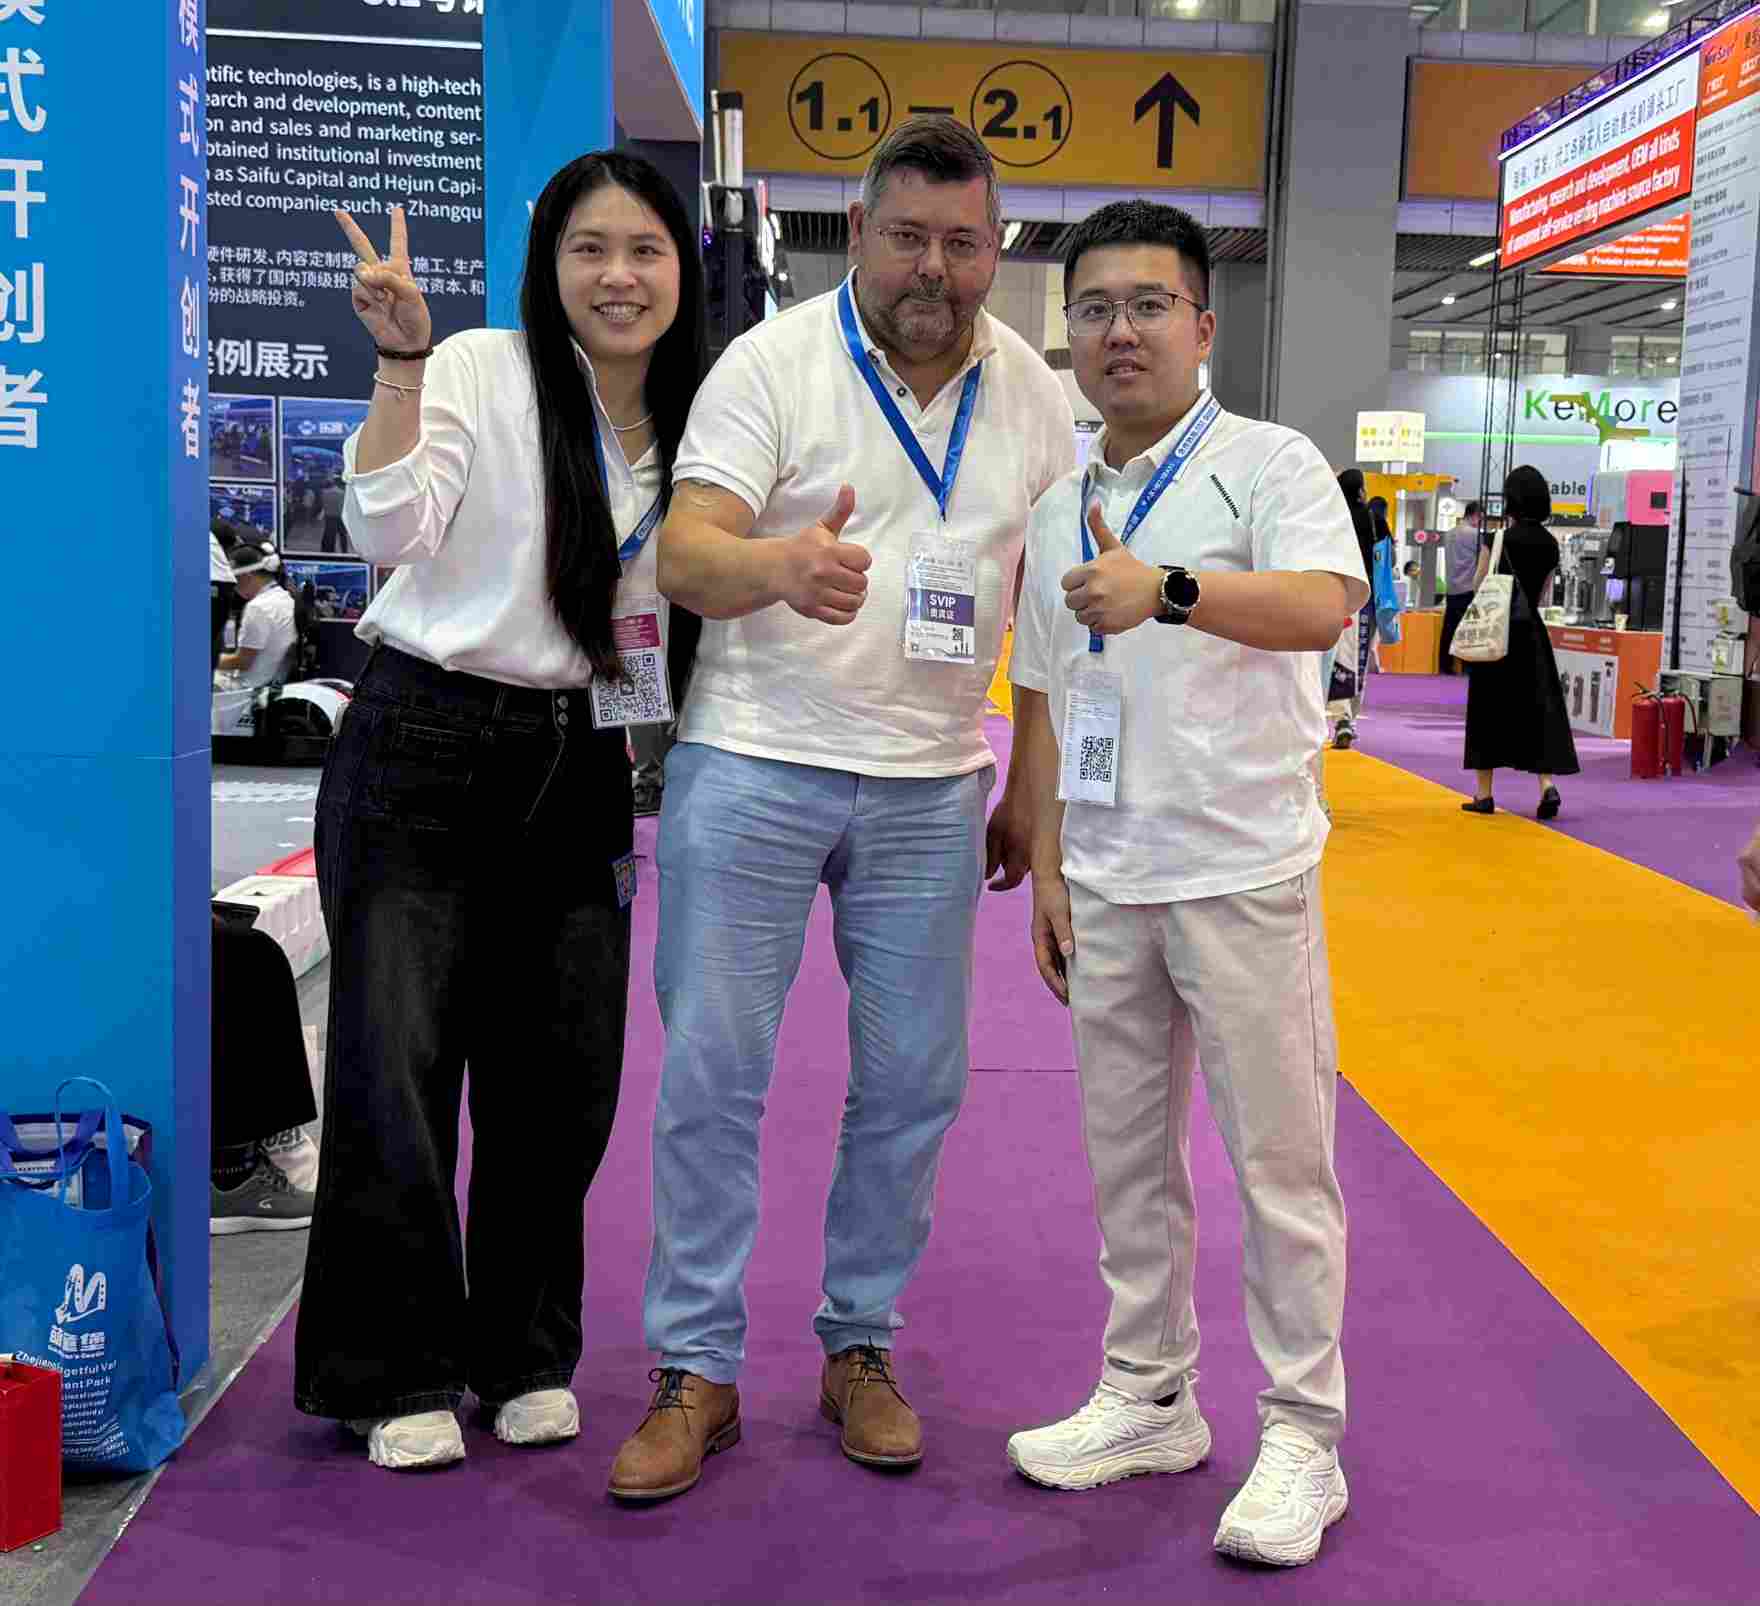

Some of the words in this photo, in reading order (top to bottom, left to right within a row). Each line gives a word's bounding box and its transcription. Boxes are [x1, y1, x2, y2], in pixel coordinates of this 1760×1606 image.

[248, 67, 362, 93] technologies,
[367, 73, 382, 90] is
[387, 78, 397, 91] a
[402, 74, 481, 97] high-tech
[254, 93, 286, 110] and
[292, 94, 411, 119] development,
[416, 104, 483, 121] content
[796, 81, 881, 132] 1.1
[981, 89, 1063, 140] 2.1
[231, 116, 263, 134] and
[270, 118, 313, 136] sales
[319, 121, 351, 139] and
[358, 124, 445, 148] marketing
[450, 131, 483, 145] ser-
[278, 143, 380, 165] institutional
[388, 149, 483, 170] investment
[215, 168, 233, 182] as
[238, 166, 280, 184] Saifu
[284, 168, 344, 190] Capital
[348, 173, 380, 190] and
[385, 174, 435, 195] Hejun
[438, 177, 483, 198] Capi-
[246, 195, 338, 213] companies
[341, 197, 382, 214] such
[408, 200, 483, 223] Zhangqu
[177, 0, 200, 459] 模式开创者
[208, 340, 329, 380] 例展示
[928, 593, 956, 609] SVIP
[86, 1376, 112, 1390] Park
